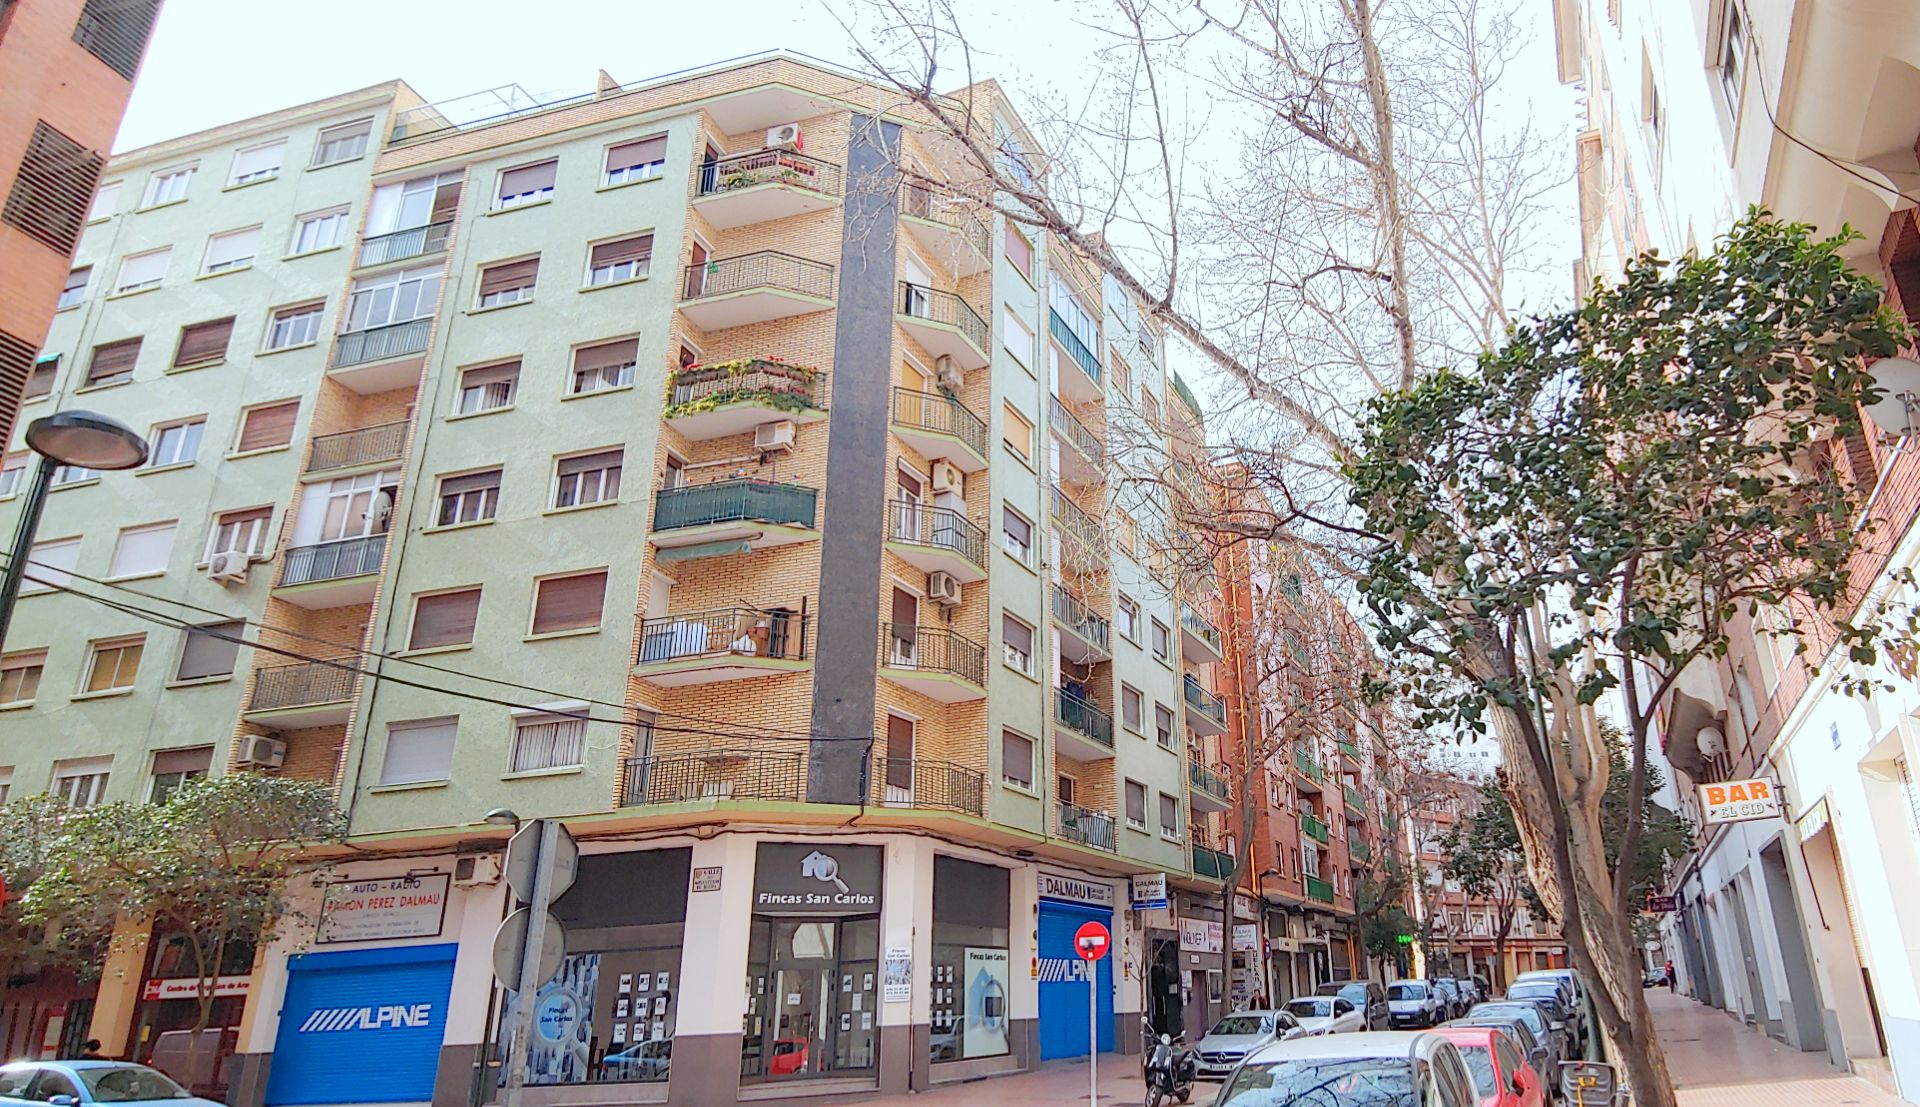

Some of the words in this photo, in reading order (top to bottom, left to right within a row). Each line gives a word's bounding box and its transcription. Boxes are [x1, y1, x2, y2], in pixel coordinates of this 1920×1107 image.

[1706, 782, 1769, 805] BAR
[1720, 807, 1736, 818] EL
[1739, 803, 1764, 815] CID
[352, 883, 378, 893] AUTO
[390, 880, 421, 890] RADIO
[1046, 878, 1086, 899] DALMAU
[368, 897, 395, 909] PEREZ
[400, 893, 440, 907] DALMAU
[759, 893, 802, 904] Fincas
[806, 893, 830, 904] San
[834, 893, 874, 904] Carlos
[344, 1004, 432, 1029] ALPINE
